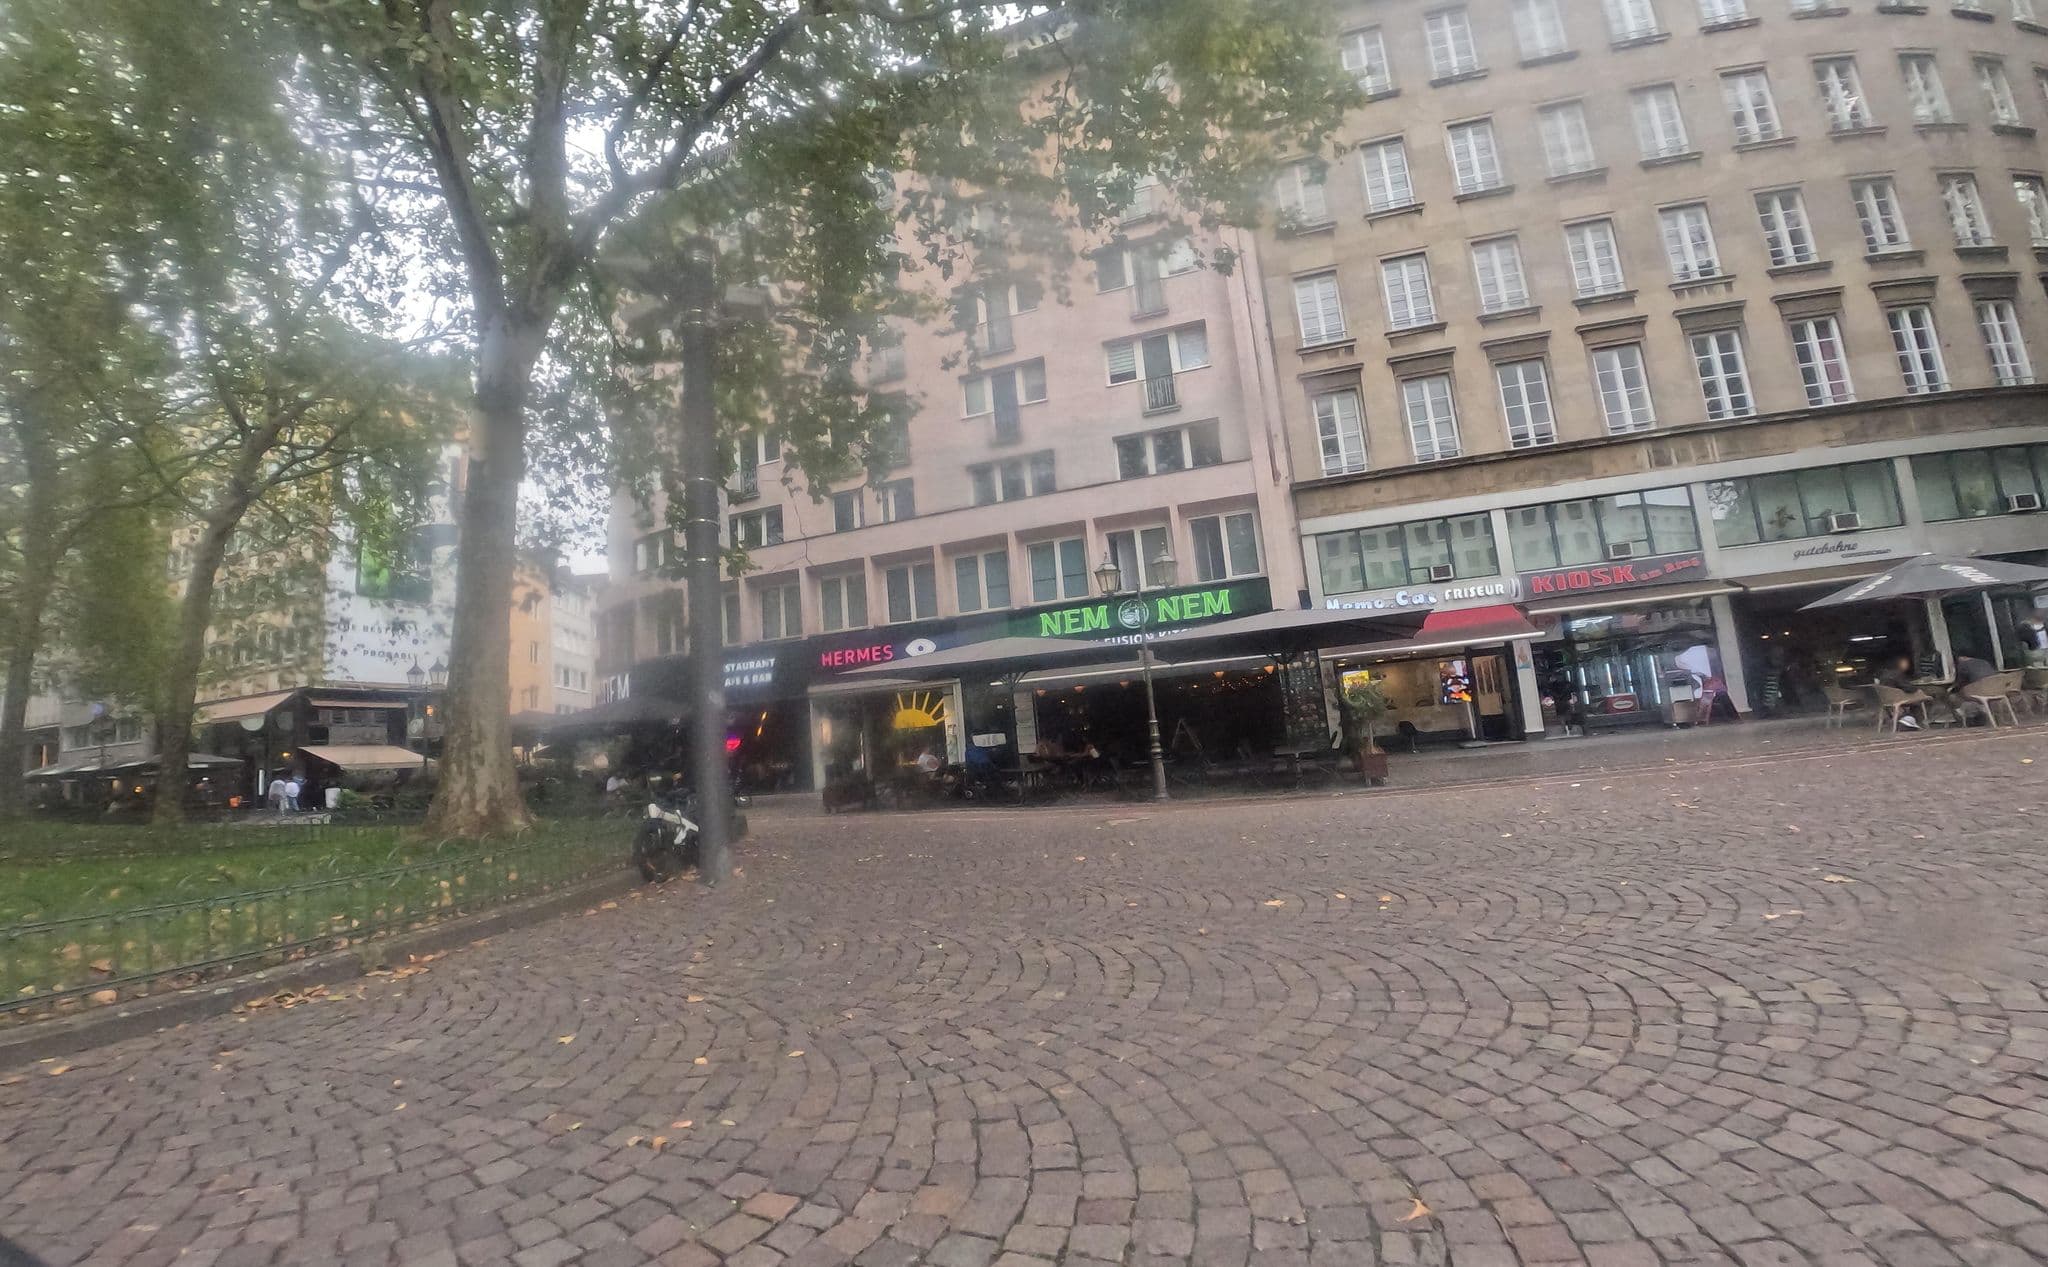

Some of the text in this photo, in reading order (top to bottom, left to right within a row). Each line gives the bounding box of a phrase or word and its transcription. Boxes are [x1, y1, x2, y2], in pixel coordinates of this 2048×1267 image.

[1531, 564, 1636, 593] KIOSK
[1444, 583, 1505, 601] FRISEUR
[1040, 589, 1232, 637] NEM NEM
[821, 644, 894, 667] HERMES
